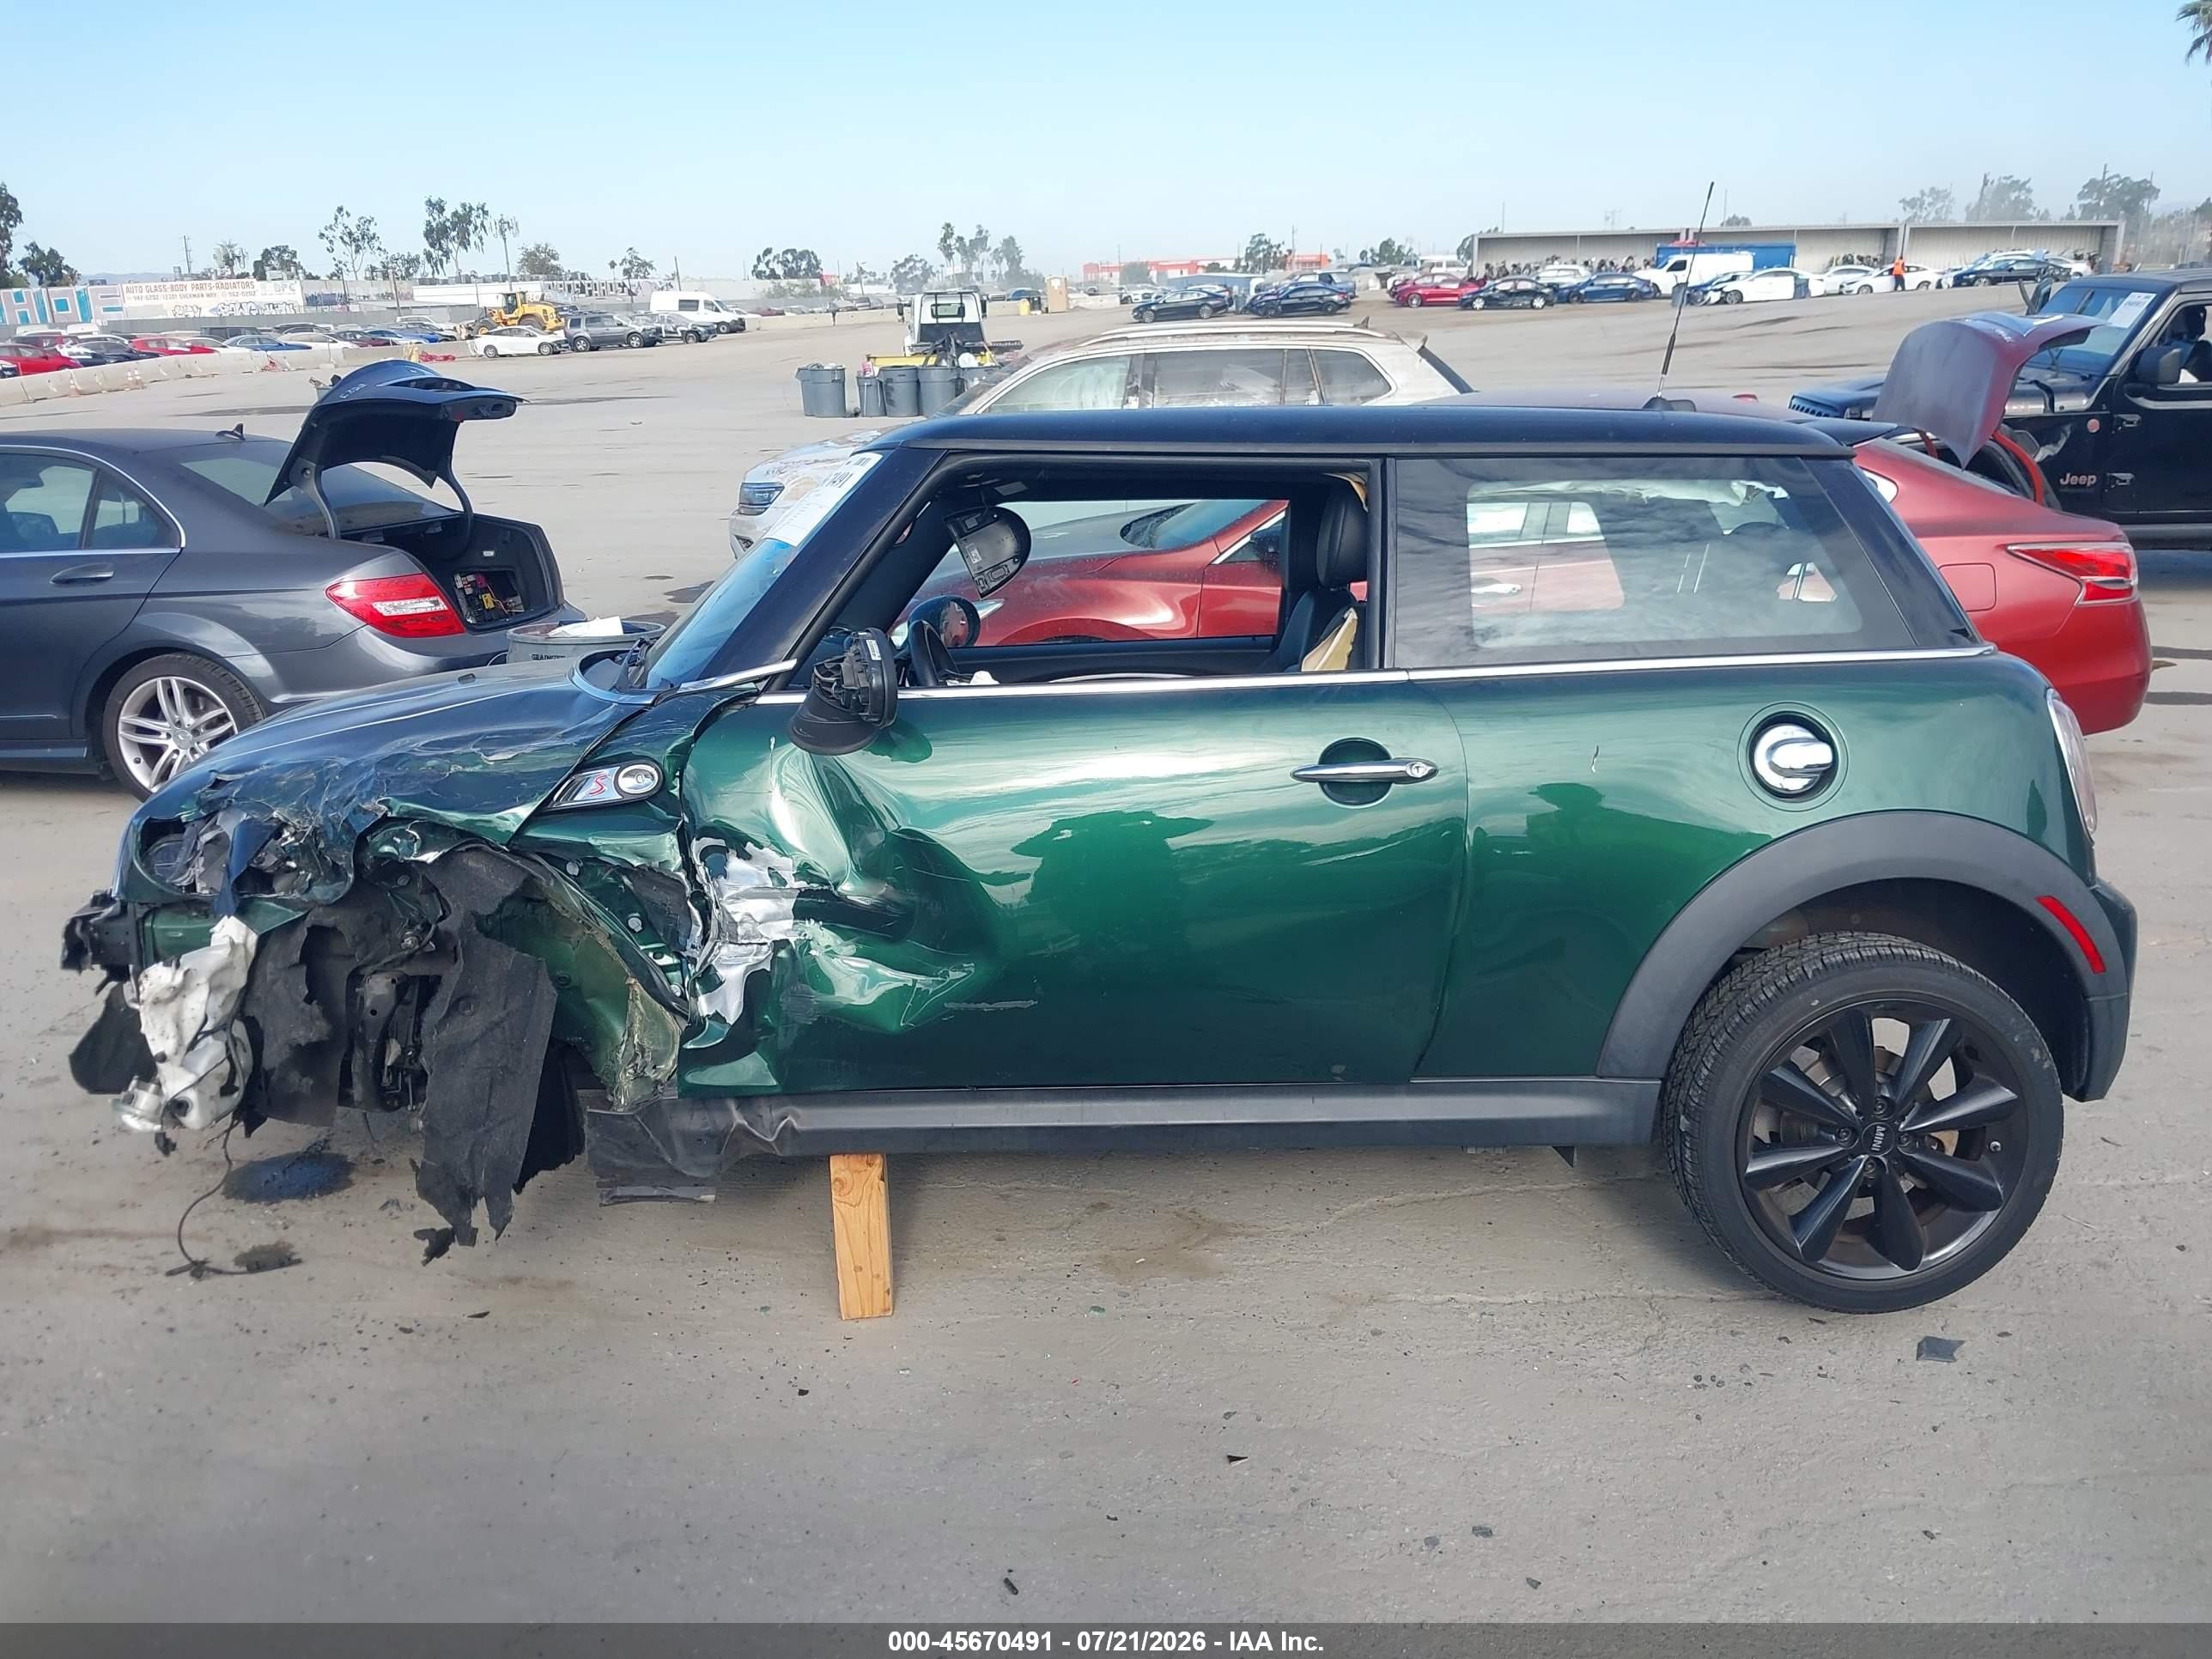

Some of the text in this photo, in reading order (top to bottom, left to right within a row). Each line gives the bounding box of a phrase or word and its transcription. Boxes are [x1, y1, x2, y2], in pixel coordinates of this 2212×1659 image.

[125, 285, 143, 294] AUTO
[2059, 472, 2097, 487] Jeep
[588, 774, 609, 797] S
[1871, 1125, 1887, 1152] MINI
